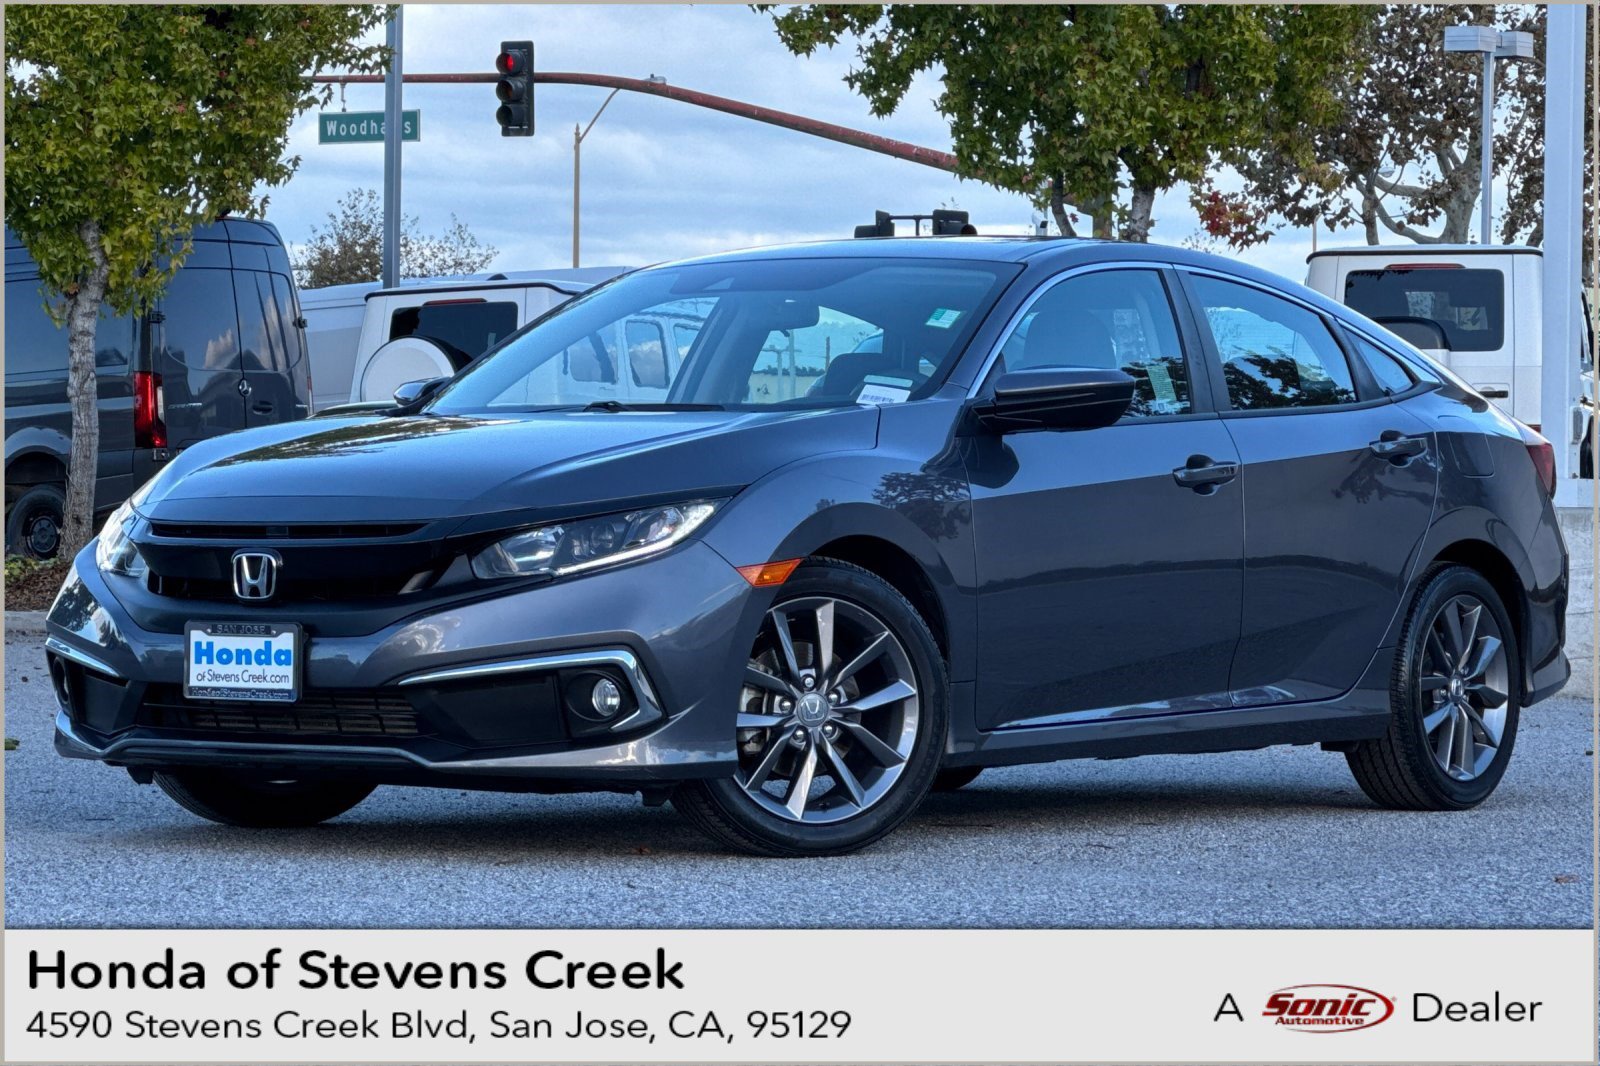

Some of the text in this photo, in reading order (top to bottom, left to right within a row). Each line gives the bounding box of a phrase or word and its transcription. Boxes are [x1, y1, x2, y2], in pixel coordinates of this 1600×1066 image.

[326, 120, 411, 136] Woodhas
[216, 624, 266, 635] SAN JOSE
[194, 640, 292, 666] Honda
